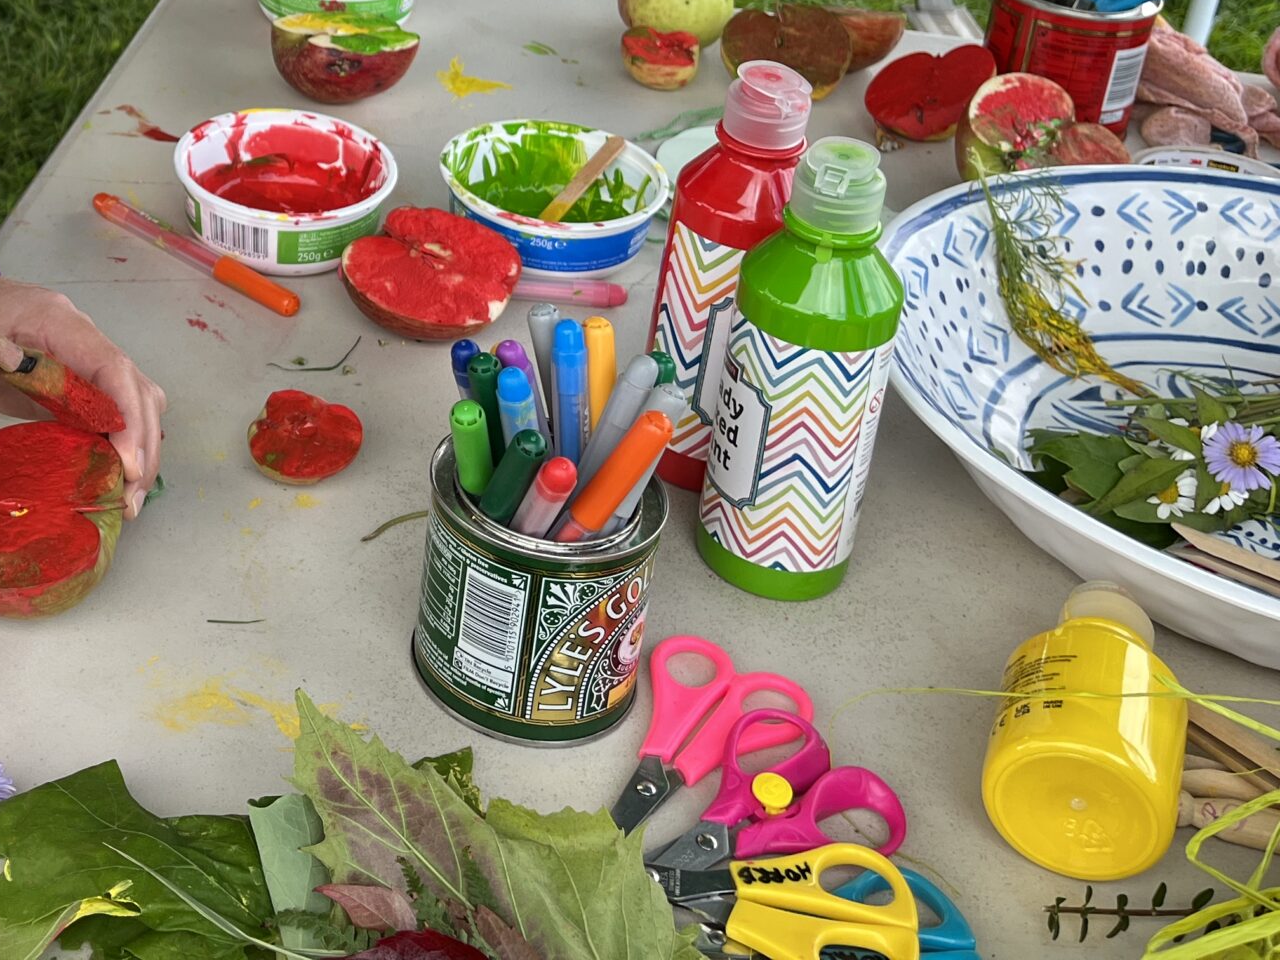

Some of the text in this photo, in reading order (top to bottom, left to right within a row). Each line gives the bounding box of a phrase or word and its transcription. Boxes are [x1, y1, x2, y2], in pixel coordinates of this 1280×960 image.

[529, 236, 554, 250] 250g
[297, 251, 321, 263] 250g
[538, 620, 606, 711] LYLE'S
